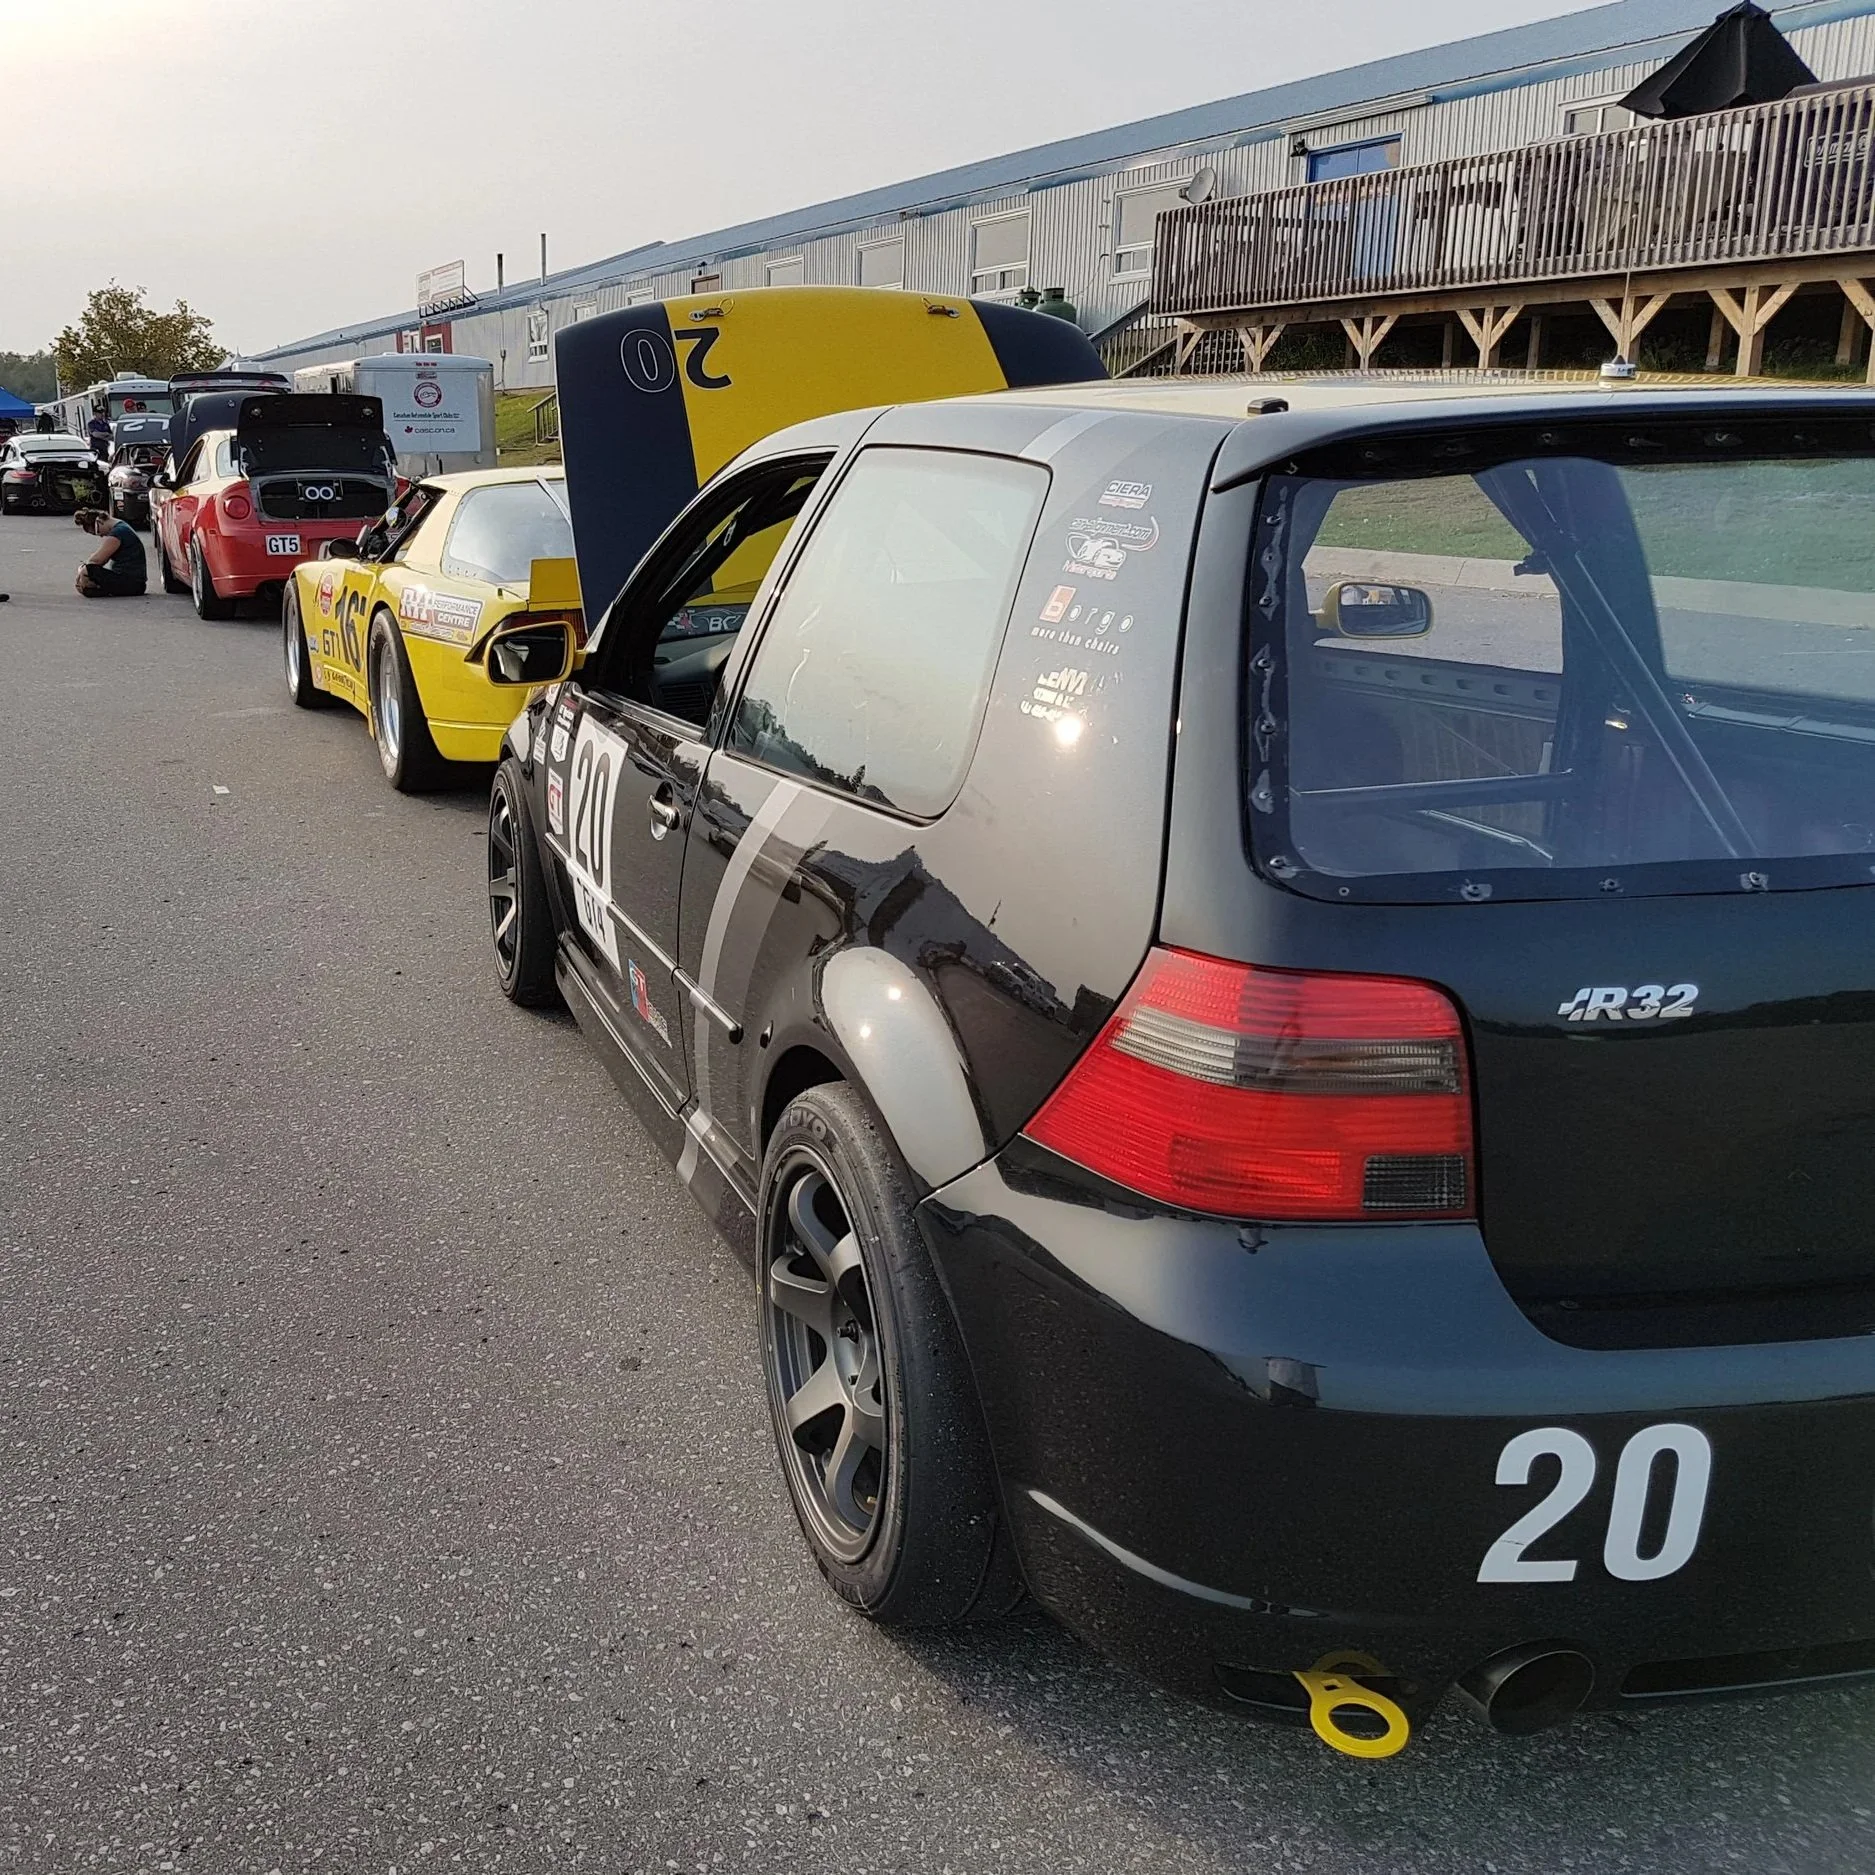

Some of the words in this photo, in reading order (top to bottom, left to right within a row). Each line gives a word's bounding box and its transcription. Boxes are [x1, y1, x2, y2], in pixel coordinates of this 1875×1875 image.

[1106, 482, 1150, 497] CIERA
[268, 537, 298, 553] GT5
[438, 612, 470, 628] CENTRE
[1031, 626, 1056, 640] more
[1058, 630, 1081, 646] than
[1085, 637, 1120, 655] chairs
[576, 739, 610, 889] 20
[1568, 984, 1699, 1021] R32
[1477, 1423, 1711, 1582] 20
